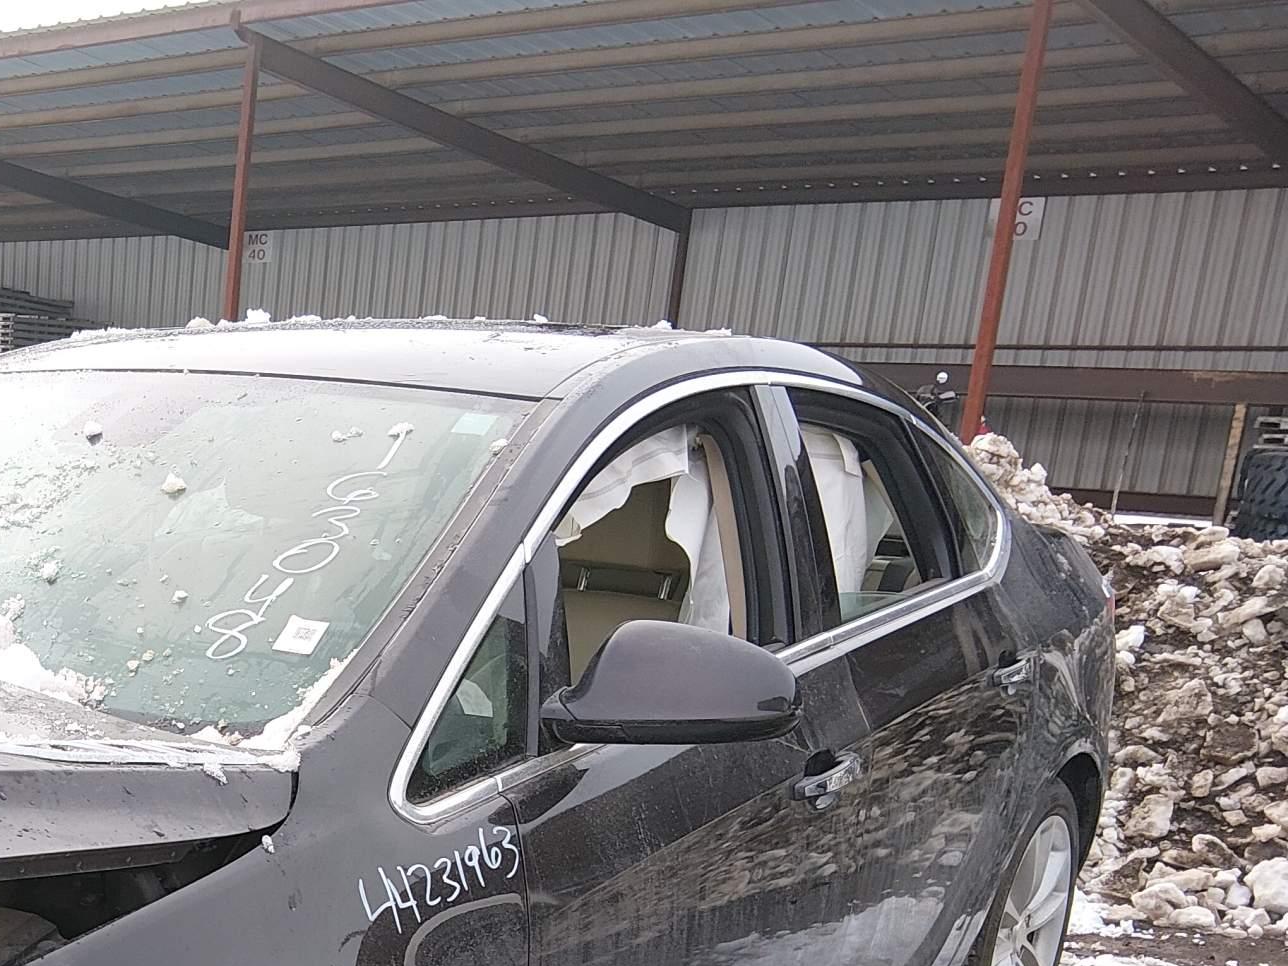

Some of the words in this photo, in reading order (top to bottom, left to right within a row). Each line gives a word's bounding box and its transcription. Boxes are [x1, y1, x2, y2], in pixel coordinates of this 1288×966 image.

[248, 233, 268, 246] MC
[248, 249, 266, 261] 40
[358, 826, 520, 934] 44231963
